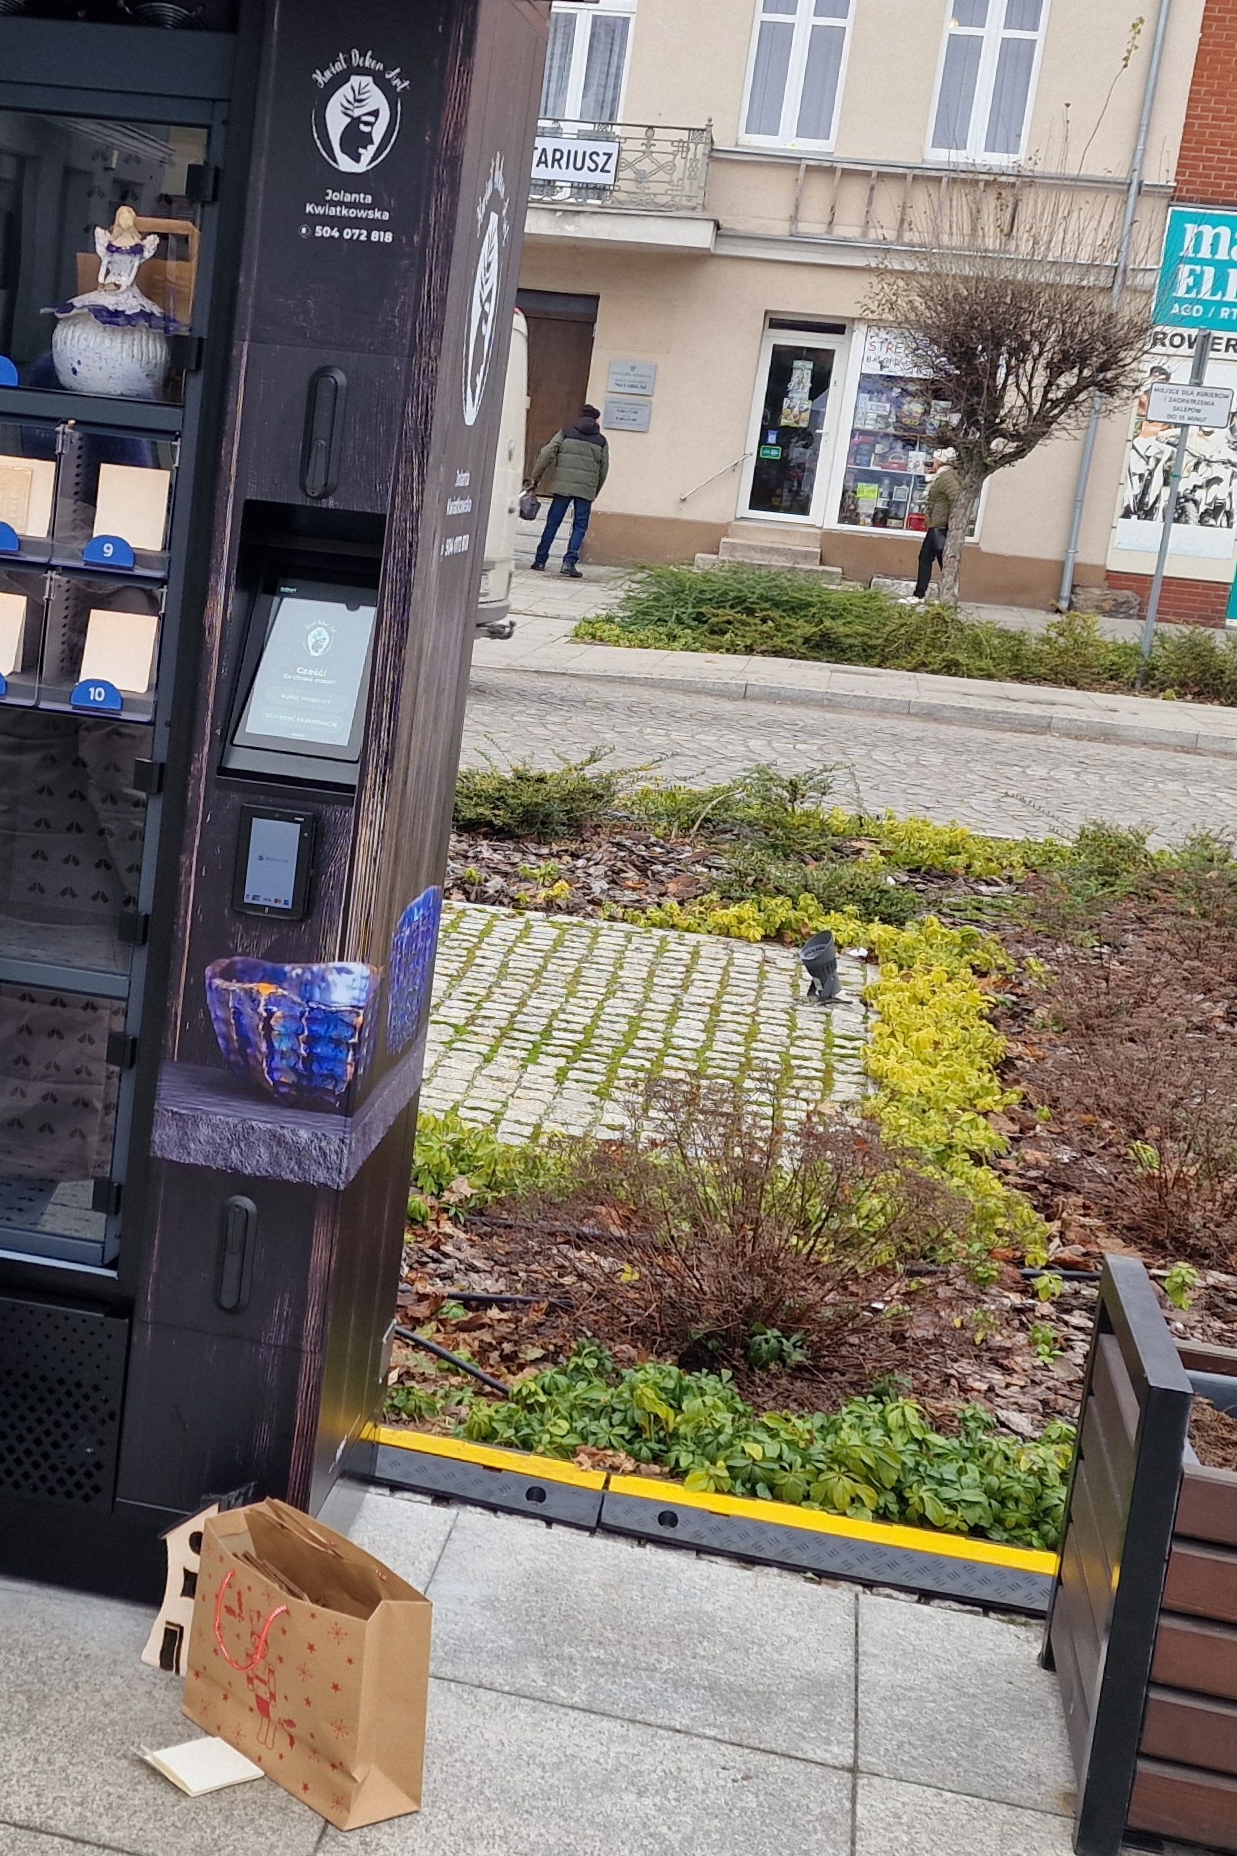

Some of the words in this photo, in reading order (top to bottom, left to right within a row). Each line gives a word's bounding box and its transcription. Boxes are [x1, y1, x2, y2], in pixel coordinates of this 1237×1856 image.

[312, 52, 348, 89] Kwiat
[350, 48, 384, 72] Dekor
[533, 146, 614, 174] ARIUSZ
[324, 189, 373, 204] Jolanta
[305, 202, 390, 220] Kwiatkowska
[314, 225, 340, 238] 504
[343, 228, 368, 241] 072
[370, 230, 393, 243] 818
[102, 543, 114, 558] 9
[88, 686, 106, 701] 10
